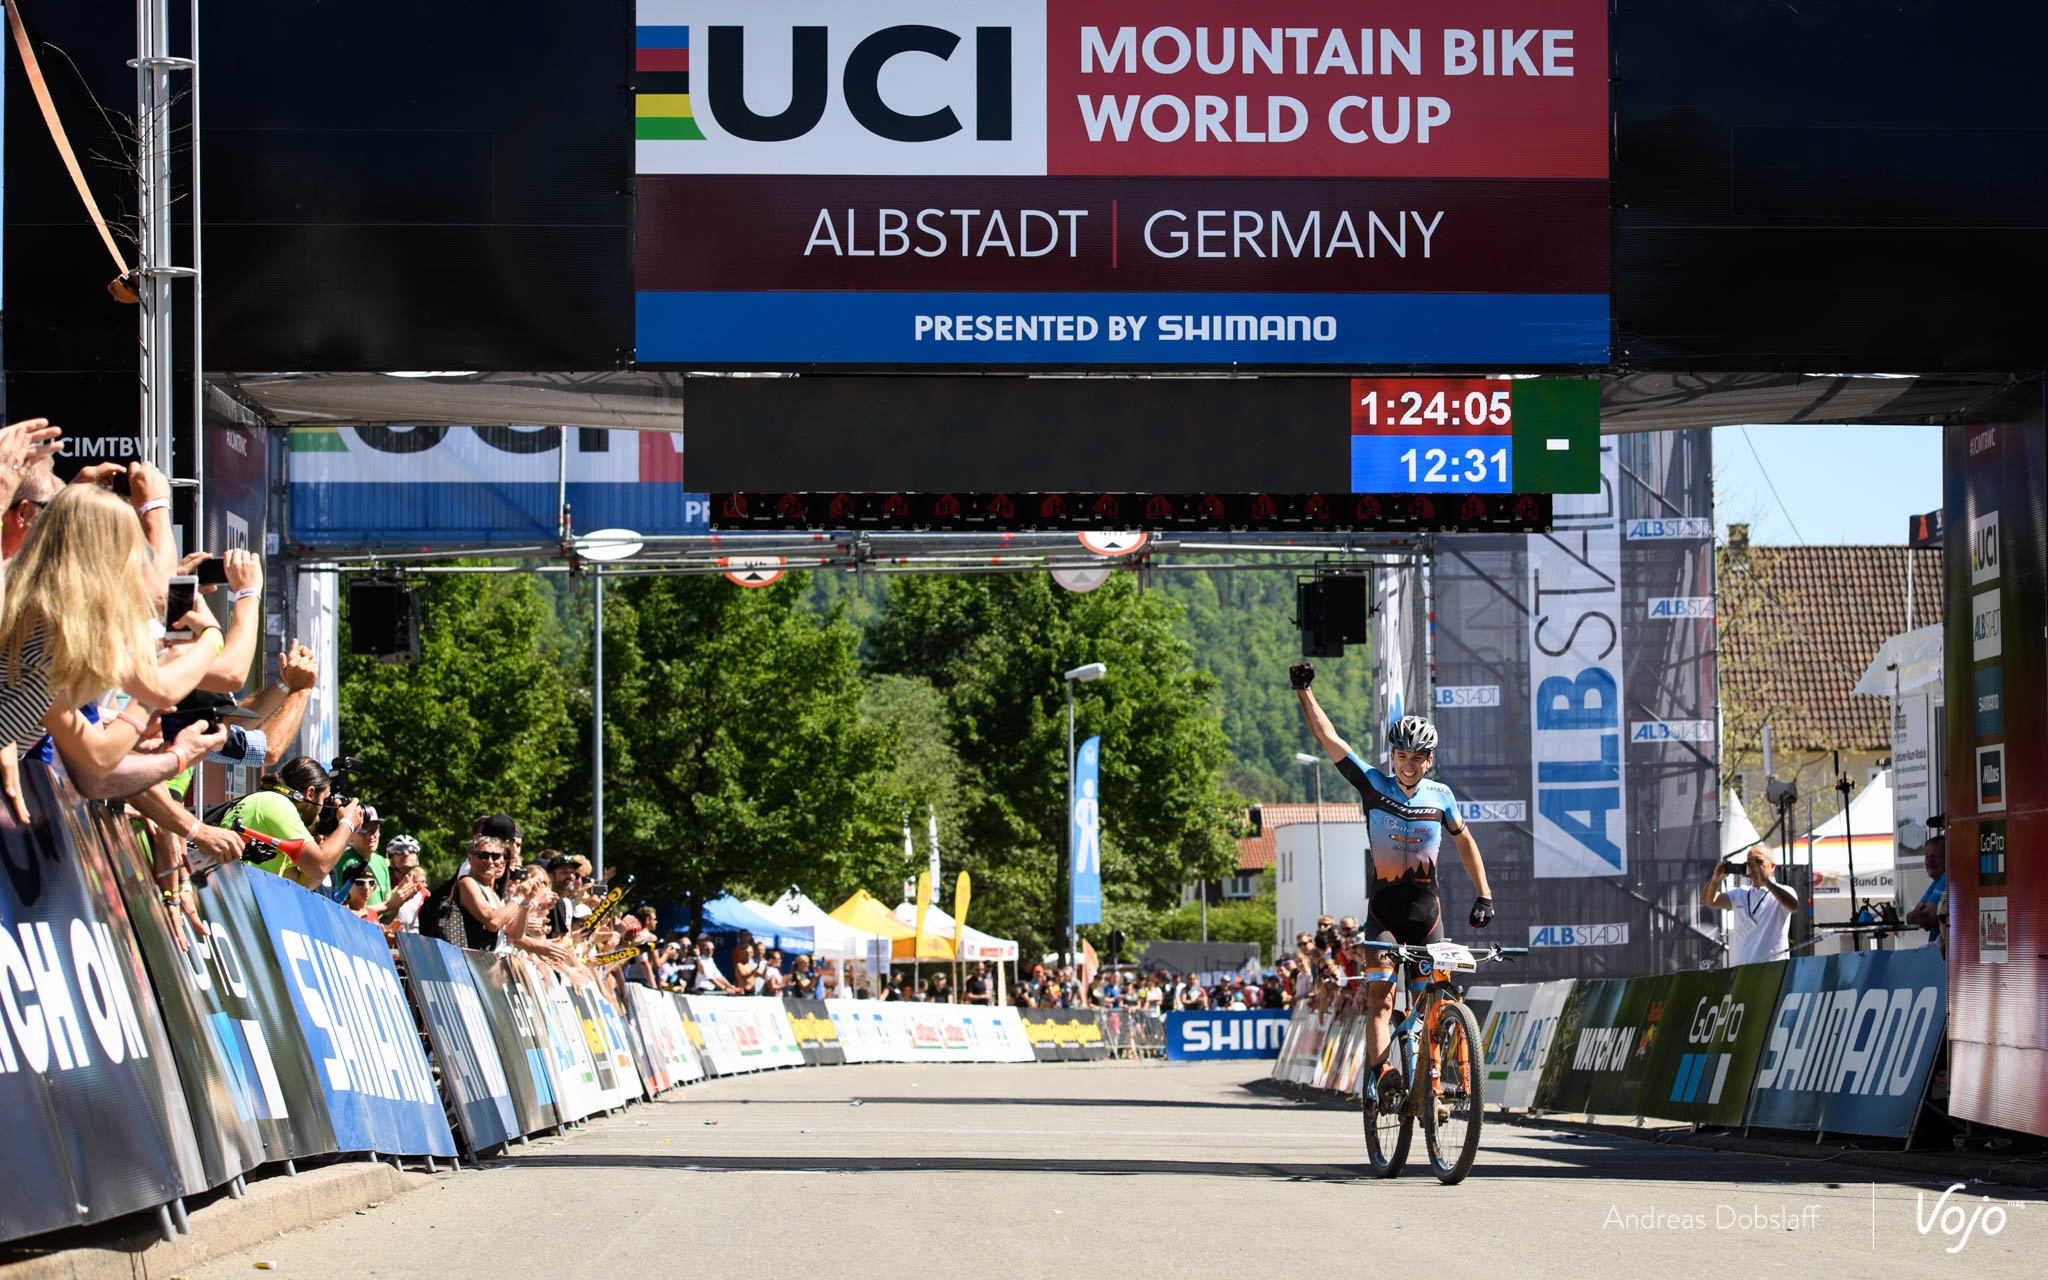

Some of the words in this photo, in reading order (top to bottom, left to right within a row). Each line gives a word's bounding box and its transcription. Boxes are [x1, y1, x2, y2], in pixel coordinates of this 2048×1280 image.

[1080, 26, 1422, 76] MOUNTAIN
[1443, 29, 1575, 77] BIKE
[707, 24, 1012, 142] UCI
[1077, 94, 1309, 143] WORLD
[1328, 95, 1451, 144] CUP
[804, 208, 1088, 258] ALBSTADT
[1144, 210, 1445, 259] GERMANY
[915, 315, 1098, 341] PRESENTED
[1108, 316, 1147, 341] BY
[1158, 315, 1337, 341] SHIMANO
[1360, 391, 1511, 425] 1:24:05
[1400, 448, 1508, 482] 12:31
[1629, 519, 1707, 537] ALBSTADT
[1977, 524, 1997, 570] UCI
[1435, 687, 1498, 705] LBSTADT
[1978, 693, 1999, 713] SHIMANO
[1458, 802, 1525, 820] LBSTADT
[1980, 832, 2004, 852] GoPro
[1531, 924, 1627, 946] ALBSTADT
[1688, 993, 1744, 1044] GoPro
[1572, 1028, 1618, 1071] WATCH
[1610, 1026, 1636, 1072] ON
[1758, 986, 1938, 1096] SHIMANO
